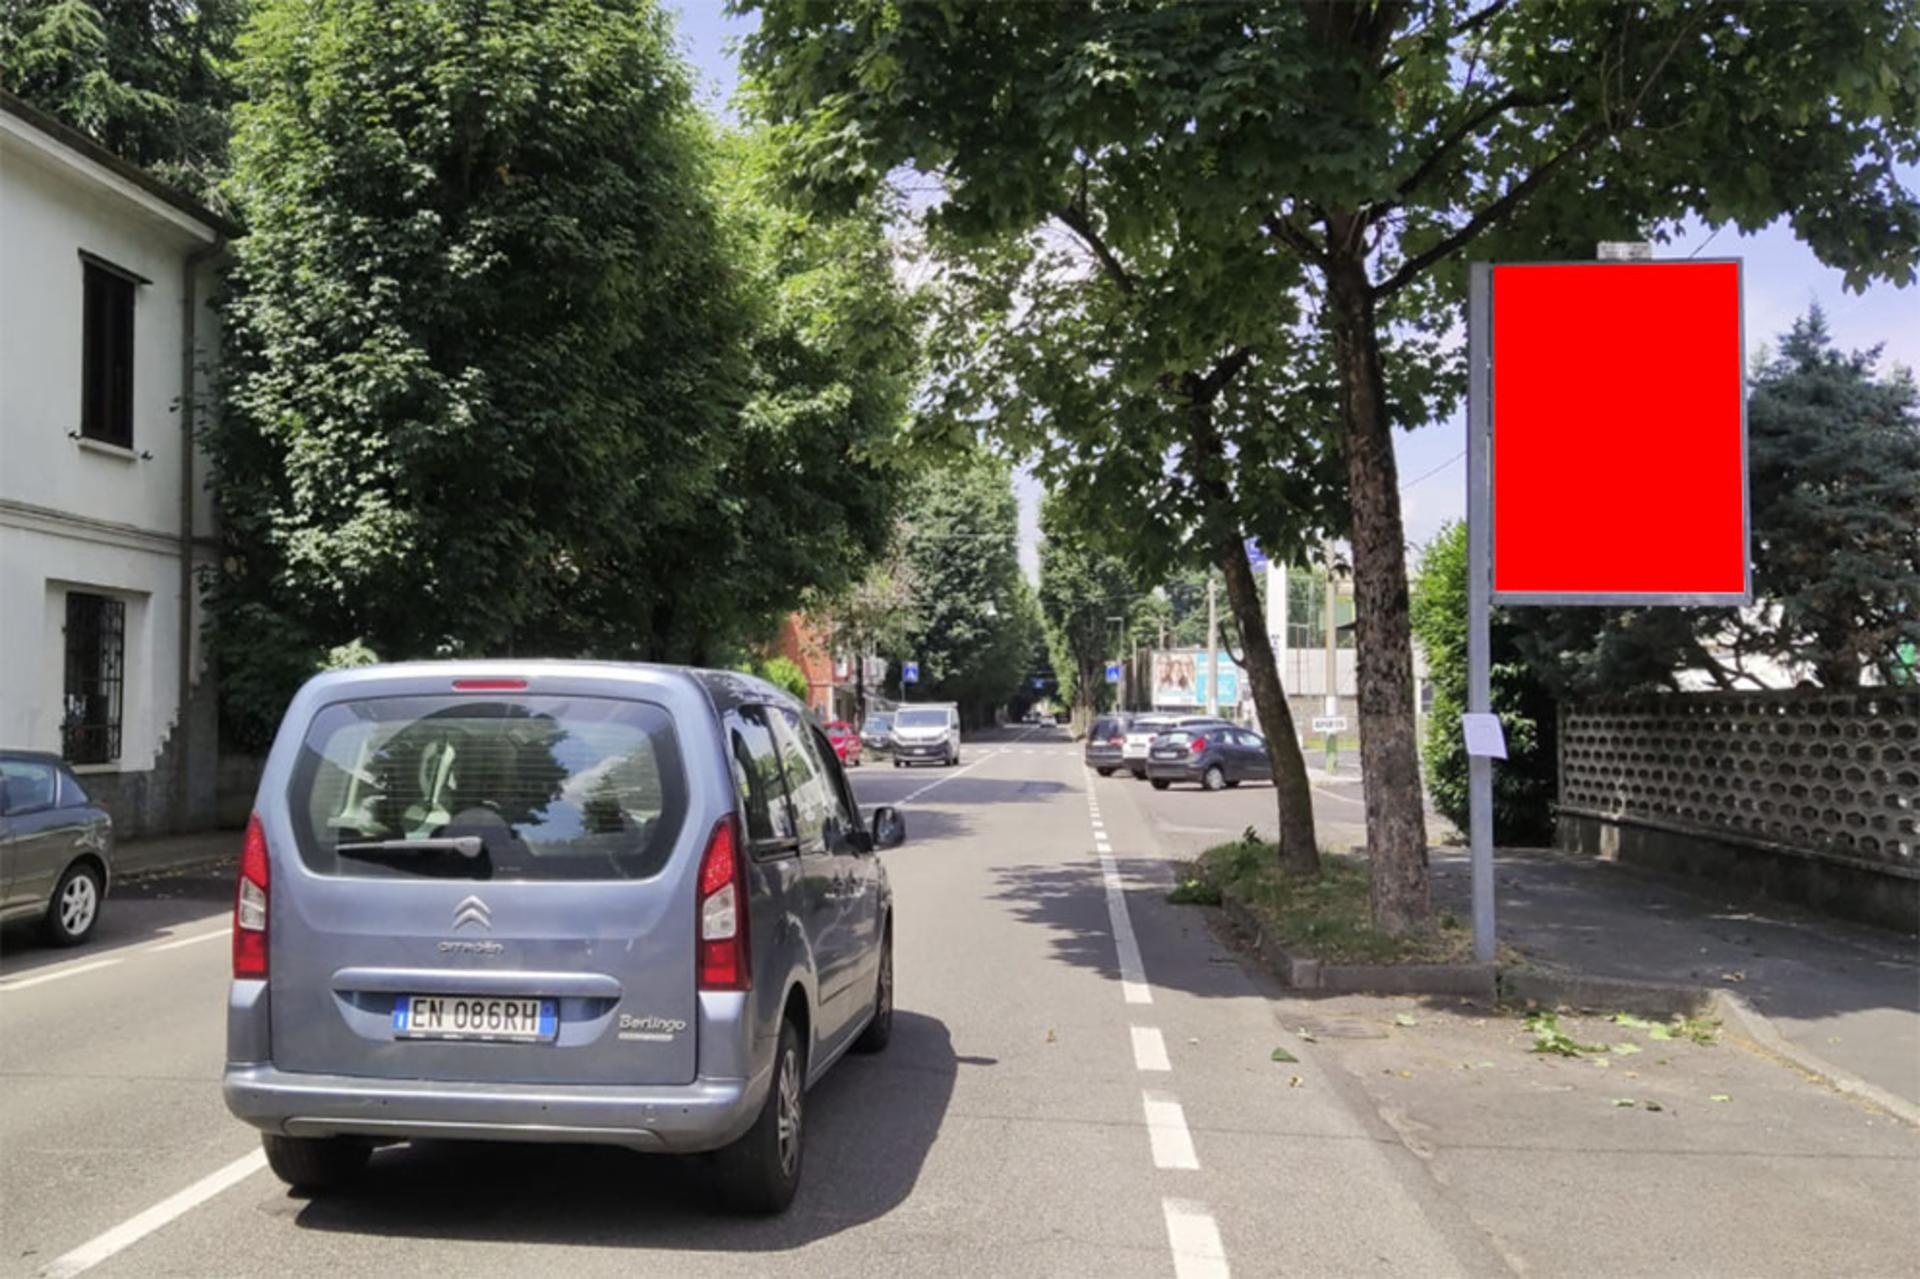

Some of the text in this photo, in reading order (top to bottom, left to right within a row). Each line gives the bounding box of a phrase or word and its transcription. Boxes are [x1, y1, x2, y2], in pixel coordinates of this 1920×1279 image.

[412, 999, 537, 1031] EN 086RH
[619, 1013, 686, 1033] Berlingo
